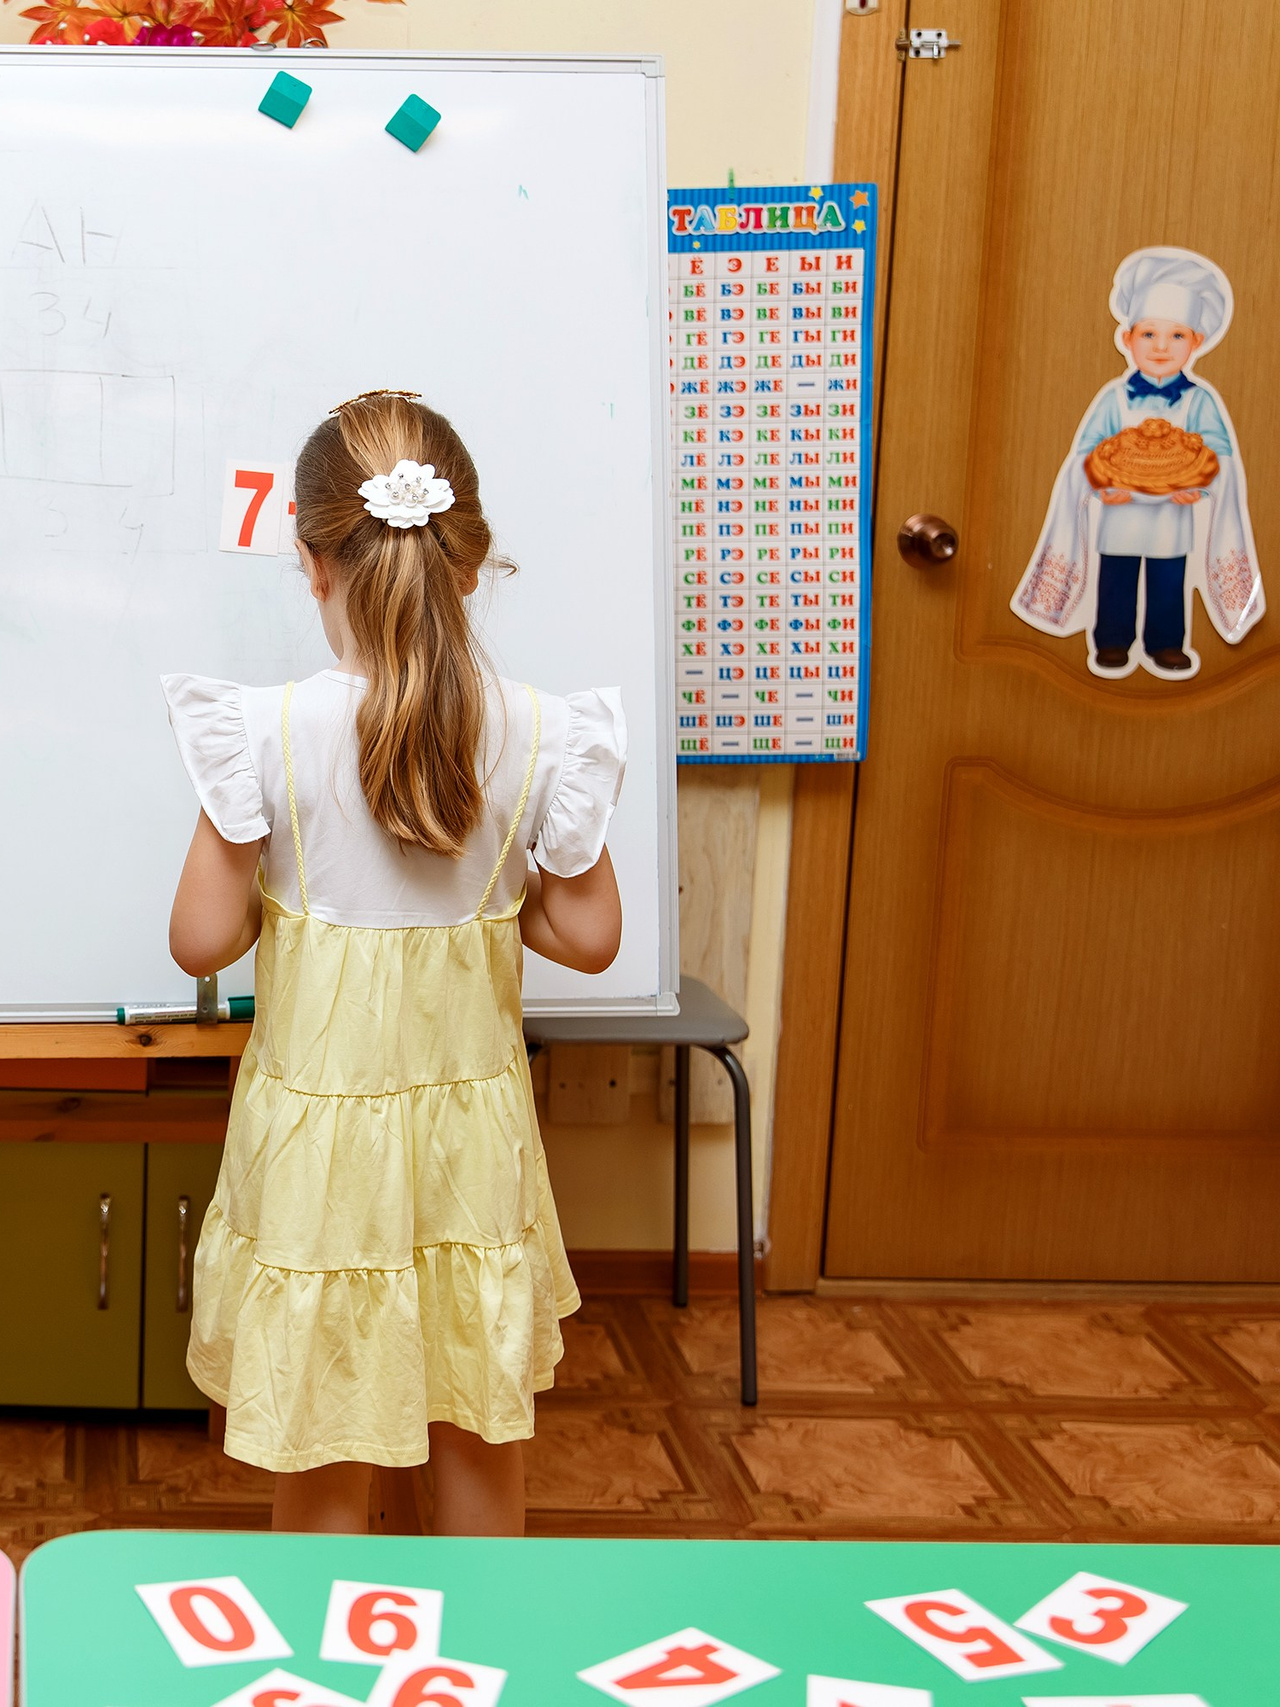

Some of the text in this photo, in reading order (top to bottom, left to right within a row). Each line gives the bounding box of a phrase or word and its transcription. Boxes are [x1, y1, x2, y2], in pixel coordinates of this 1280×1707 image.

[671, 203, 844, 234] ТАБЛИЦА
[689, 254, 854, 275] Ё Э Е Ы И
[683, 280, 858, 298] БЁ БЭ БЕ БЫ БИ
[683, 305, 858, 323] ВЁ ВЭ ВЕ ВЫ ВИ
[686, 328, 856, 346] ГЁ ГЭ ГЕ ГЫ ГИ
[683, 353, 857, 370] ДЁ ДЭ ДЕ ДЫ ДИ
[680, 378, 858, 395] ЖЁ ЖЭ ЖЕ ЖИ
[685, 403, 856, 419] ЗЁ ЗЭ ЗЕ ЗЫ ЗИ
[683, 427, 855, 443] КЁ КЭ КЕ КЫ КИ
[681, 451, 855, 467] ЛЁ ЛЭ ЛЕ ЛЫ ЛИ
[681, 475, 857, 491] МЁ МЭ МЕ МЫ МИ
[235, 469, 274, 547] 7
[680, 498, 855, 513] НЁ НЭ НЕ НЫ НИ
[682, 522, 854, 537] ПЁ ПЭ ПЕ ПЫ ПИ
[684, 546, 855, 562] РЁ РЭ РЕ РЫ РИ
[683, 570, 855, 586] СЁ СЭ СЕ СЫ СИ
[684, 593, 854, 609] ТЁ ТЭ ТЕ ТЫ ТИ
[681, 617, 856, 633] ФЁ ФЭ ФЕ ФЫ ФИ
[682, 641, 855, 657] ХЁ ХЭ ХЕ ХЫ ХИ
[718, 665, 855, 681] ЦЭ ЦЕ ЦЫ ЦИ
[682, 689, 854, 705] ЧЁ ЧЕ ЧИ
[679, 713, 855, 728] ШЁ ШЭ ШЕ ШИ
[680, 737, 855, 752] ЩЁ ЩЕ ЩИ
[169, 1586, 256, 1653] 0
[1048, 1587, 1149, 1645] 3
[904, 1599, 1027, 1669] 5
[612, 1643, 740, 1691] 4
